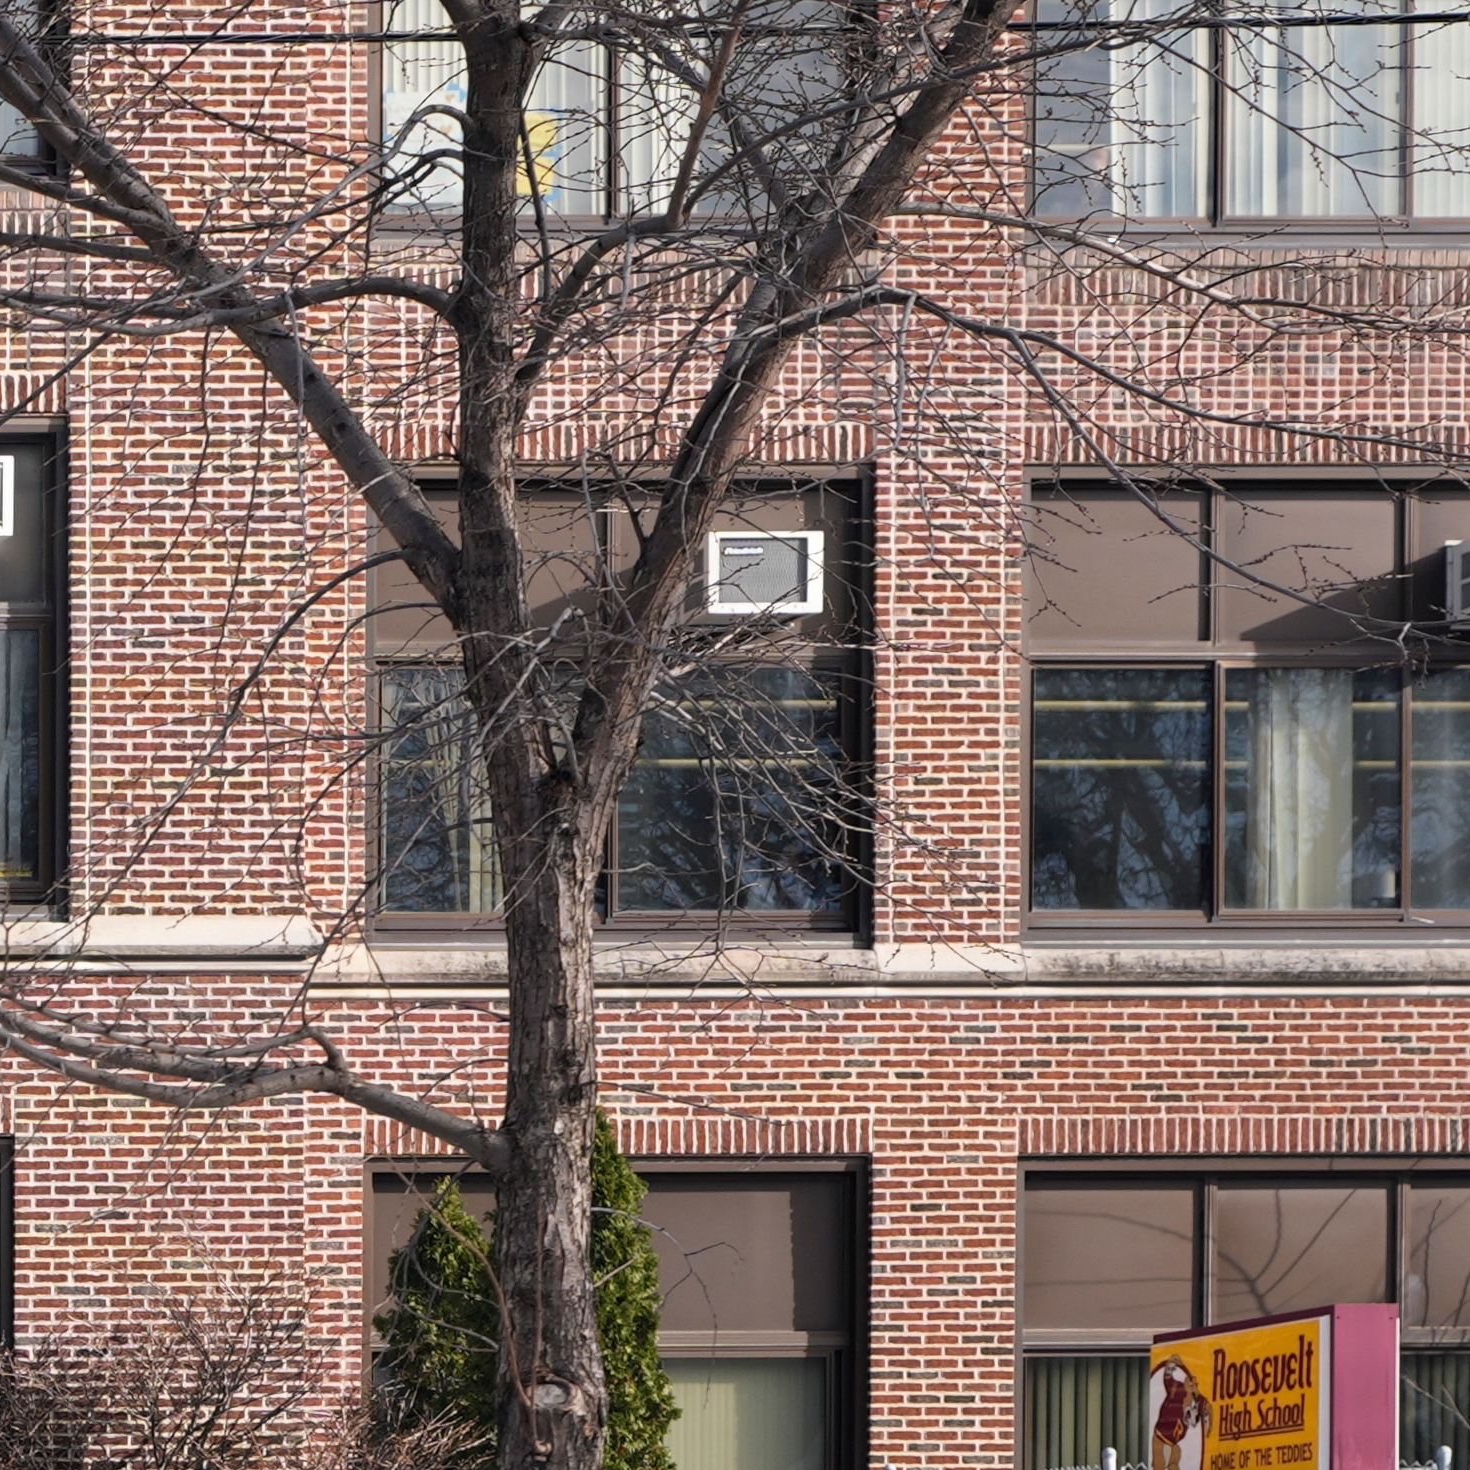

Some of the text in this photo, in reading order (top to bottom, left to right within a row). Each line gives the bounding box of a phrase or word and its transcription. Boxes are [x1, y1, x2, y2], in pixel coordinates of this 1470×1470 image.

[1211, 1334, 1314, 1403] Roosevelt
[1219, 1392, 1306, 1440] High School
[1238, 1449, 1251, 1468] OF
[1255, 1448, 1273, 1468] THE
[1275, 1442, 1313, 1466] TEDDIES
